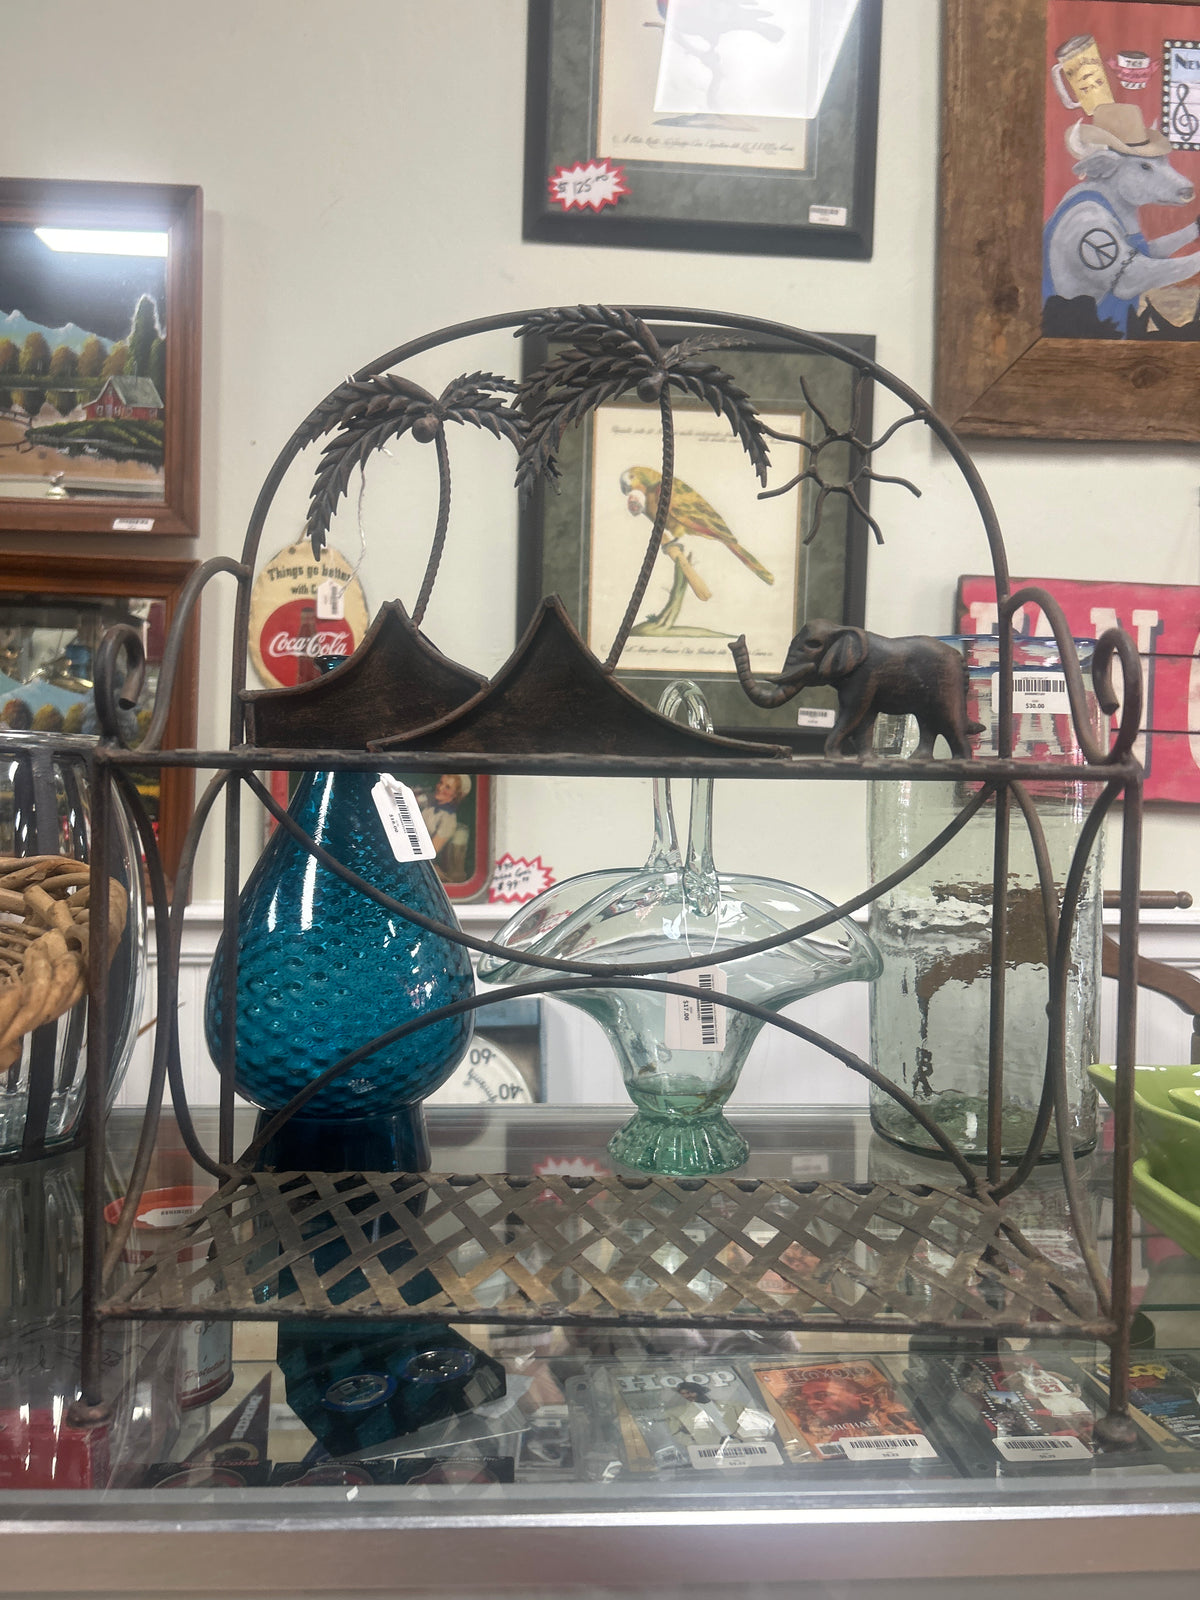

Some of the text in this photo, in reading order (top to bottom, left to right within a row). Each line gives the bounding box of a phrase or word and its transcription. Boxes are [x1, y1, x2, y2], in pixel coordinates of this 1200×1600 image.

[267, 563, 352, 581] Things go better
[291, 584, 309, 594] with
[682, 1000, 690, 1021] $17.00
[1040, 1384, 1063, 1394] 23
